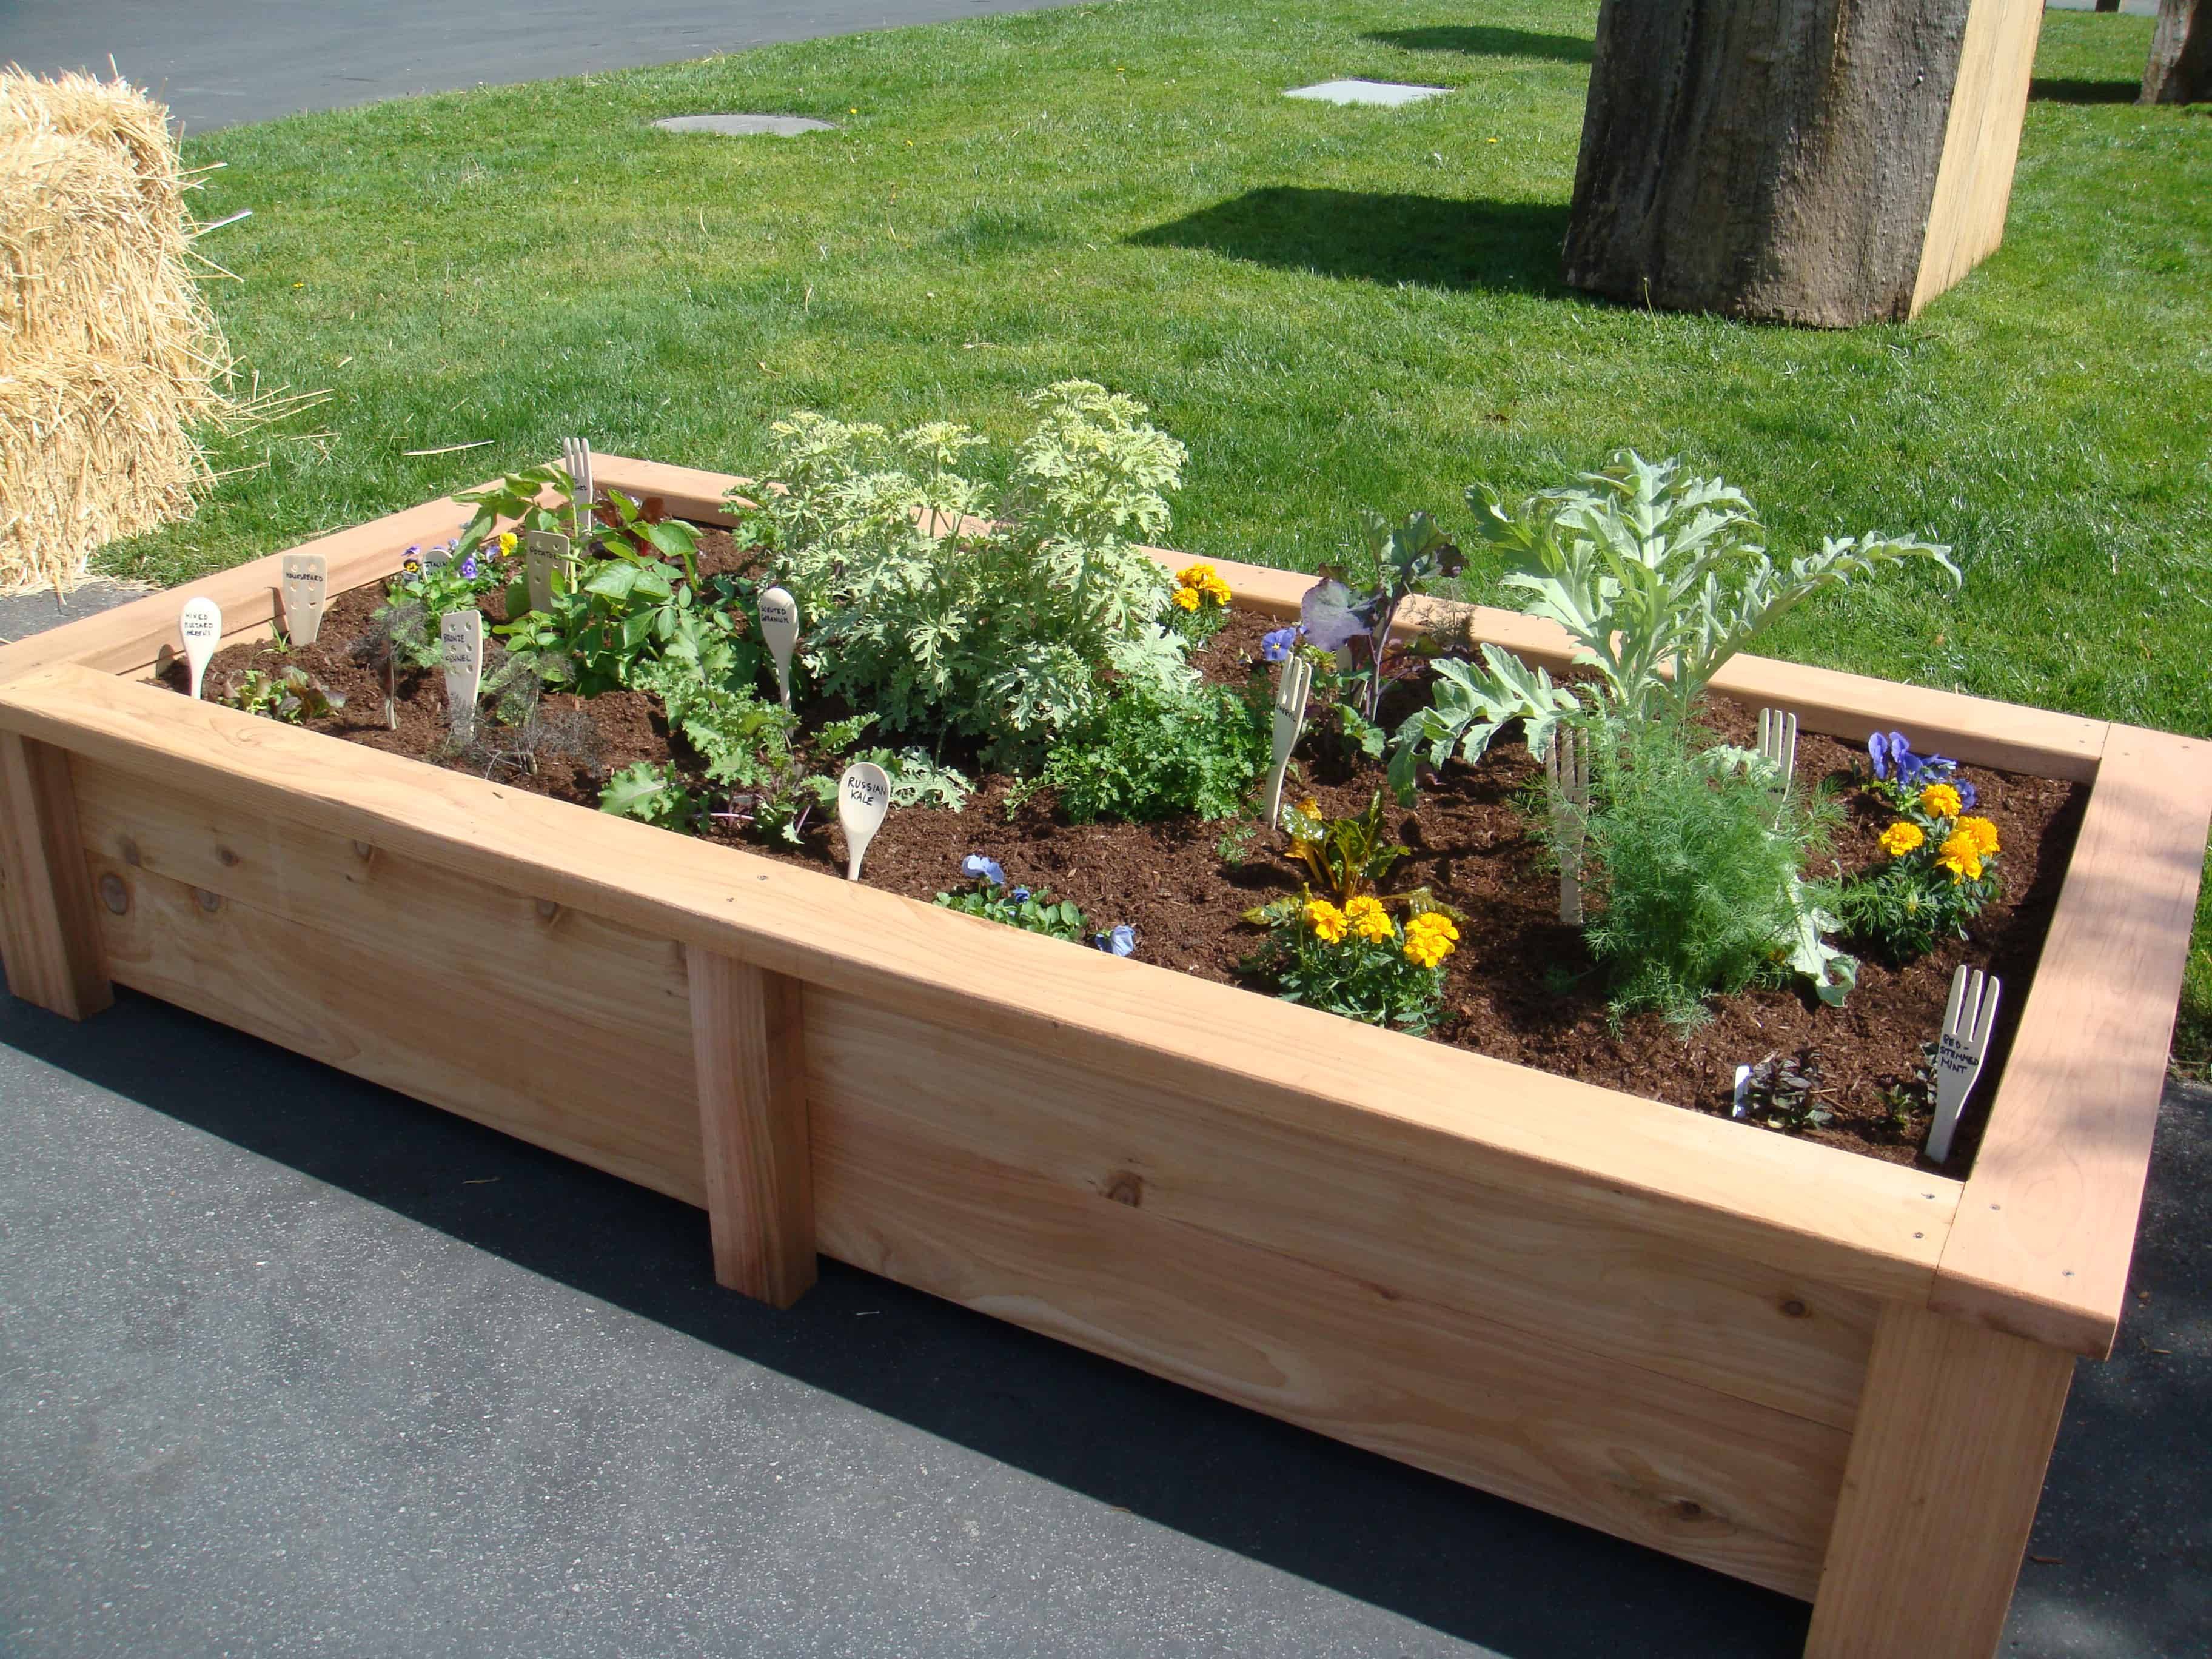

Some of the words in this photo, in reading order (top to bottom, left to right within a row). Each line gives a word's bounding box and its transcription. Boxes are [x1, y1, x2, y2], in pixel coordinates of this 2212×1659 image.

[185, 612, 208, 620] MIXED
[761, 605, 786, 615] SCENTED
[848, 776, 886, 796] RUSSIAN
[851, 789, 874, 806] KALE
[1940, 1045, 1980, 1066] STEMMED
[1940, 1056, 1968, 1074] MINT
